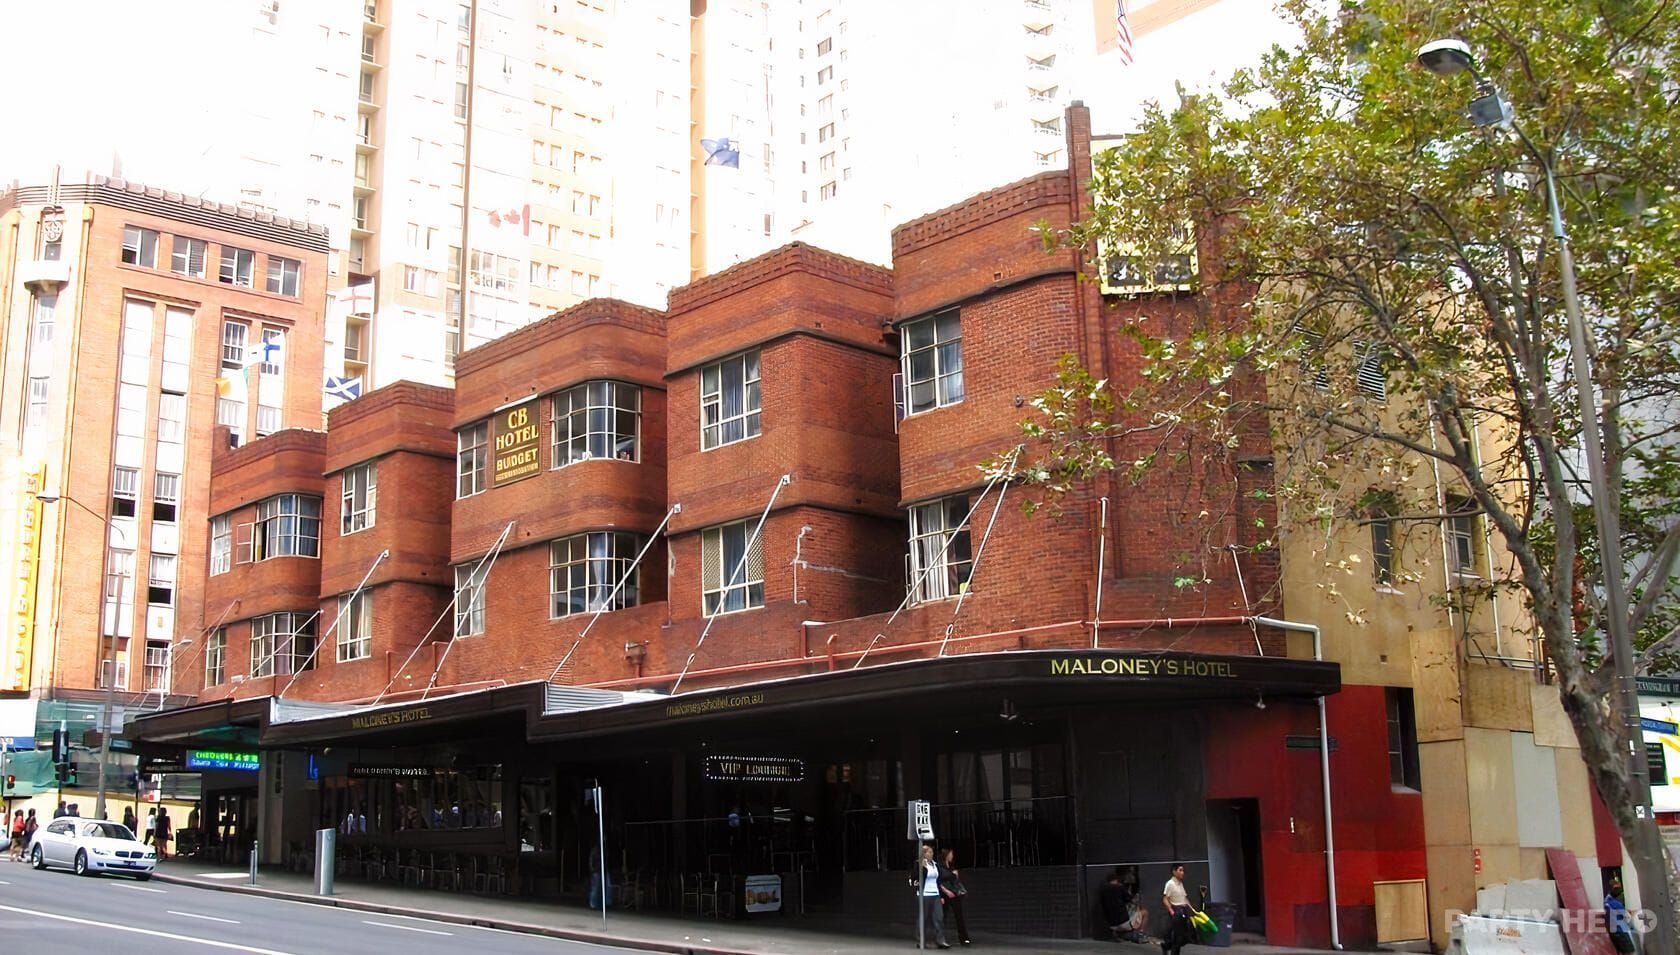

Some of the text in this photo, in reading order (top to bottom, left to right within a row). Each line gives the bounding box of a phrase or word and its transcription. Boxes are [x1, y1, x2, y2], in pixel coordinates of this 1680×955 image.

[507, 407, 528, 429] CB
[496, 424, 539, 450] HOTEL
[496, 448, 538, 471] BUDGET
[1051, 658, 1238, 677] MALONEY'S HOTEL
[401, 707, 432, 722] HOTEL
[720, 762, 741, 774] VIP
